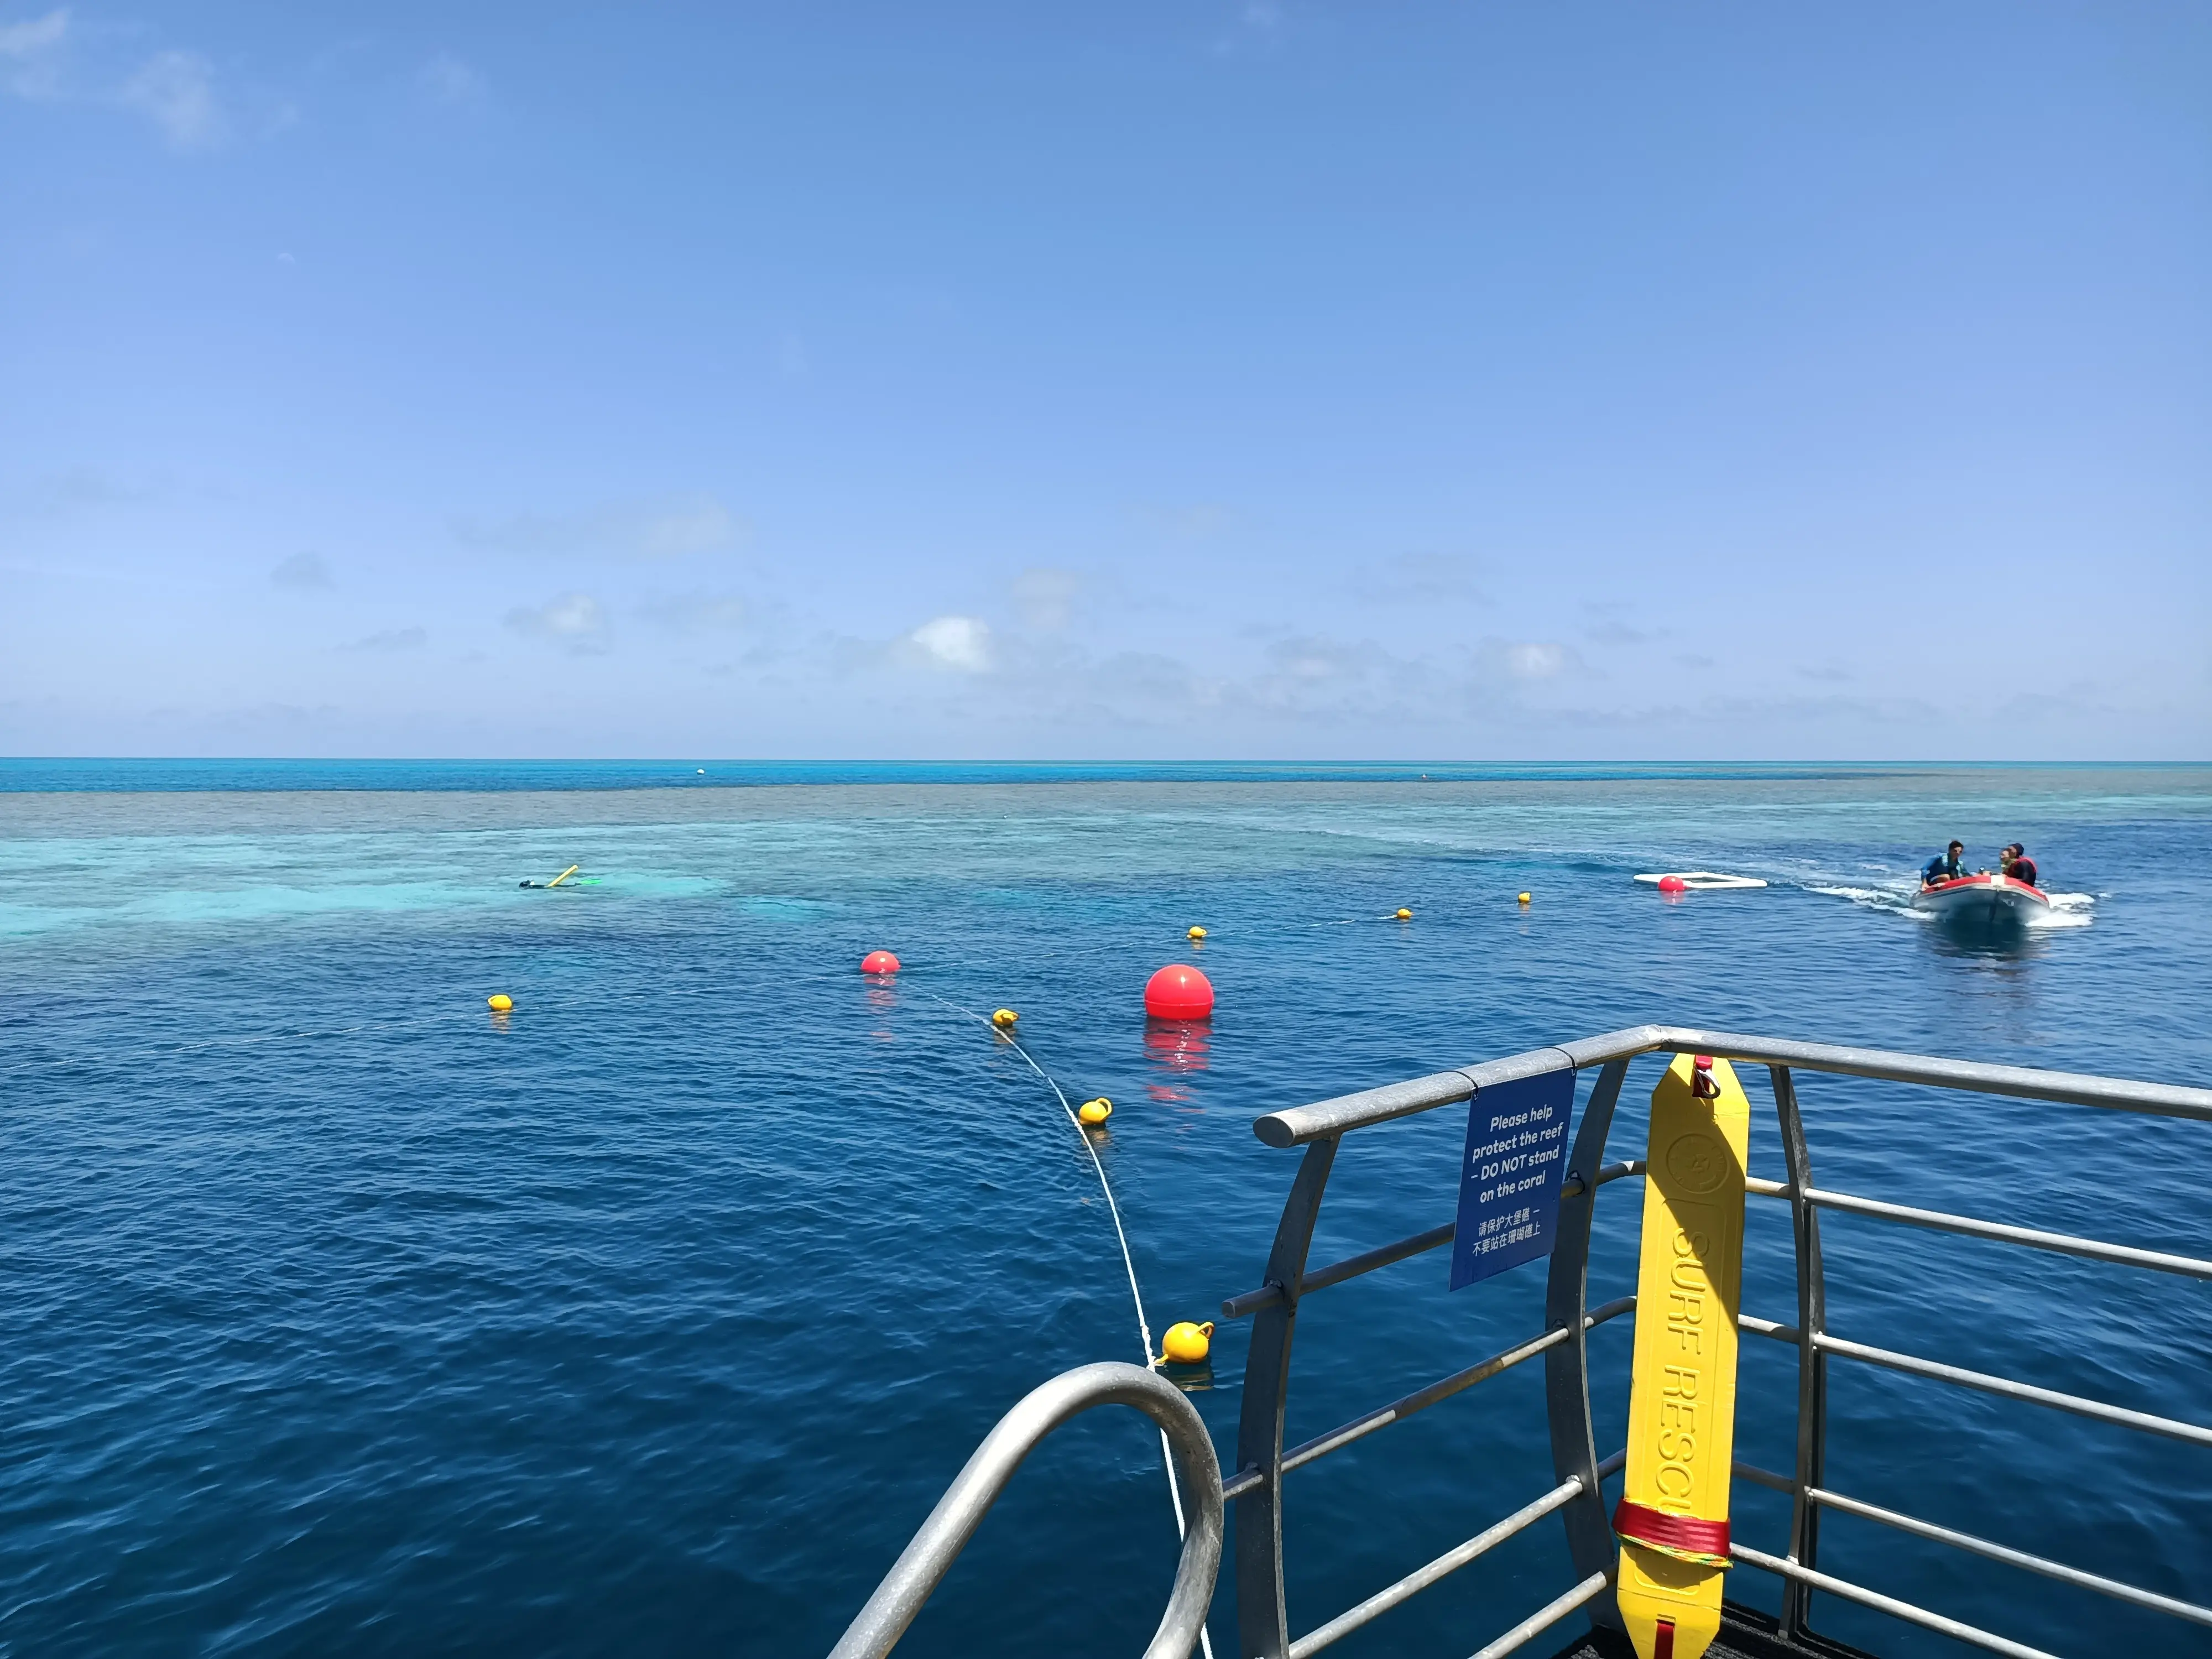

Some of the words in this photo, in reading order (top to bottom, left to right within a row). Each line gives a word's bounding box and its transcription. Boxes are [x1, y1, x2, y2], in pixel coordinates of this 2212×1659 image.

[1490, 1113, 1528, 1132] Please
[1530, 1104, 1553, 1122] help
[1472, 1135, 1517, 1164] protect
[1519, 1131, 1538, 1146] the
[1540, 1121, 1564, 1141] reef
[1481, 1162, 1499, 1181] DO
[1501, 1154, 1527, 1175] NOT
[1528, 1144, 1559, 1166] stand
[1480, 1190, 1494, 1203] on
[1496, 1182, 1516, 1198] the
[1517, 1170, 1546, 1191] coral
[1472, 1220, 1541, 1257] 不要站在珊瑚礁上
[1478, 1207, 1530, 1237] 请保护大堡礁
[1667, 1227, 1710, 1355] SURF
